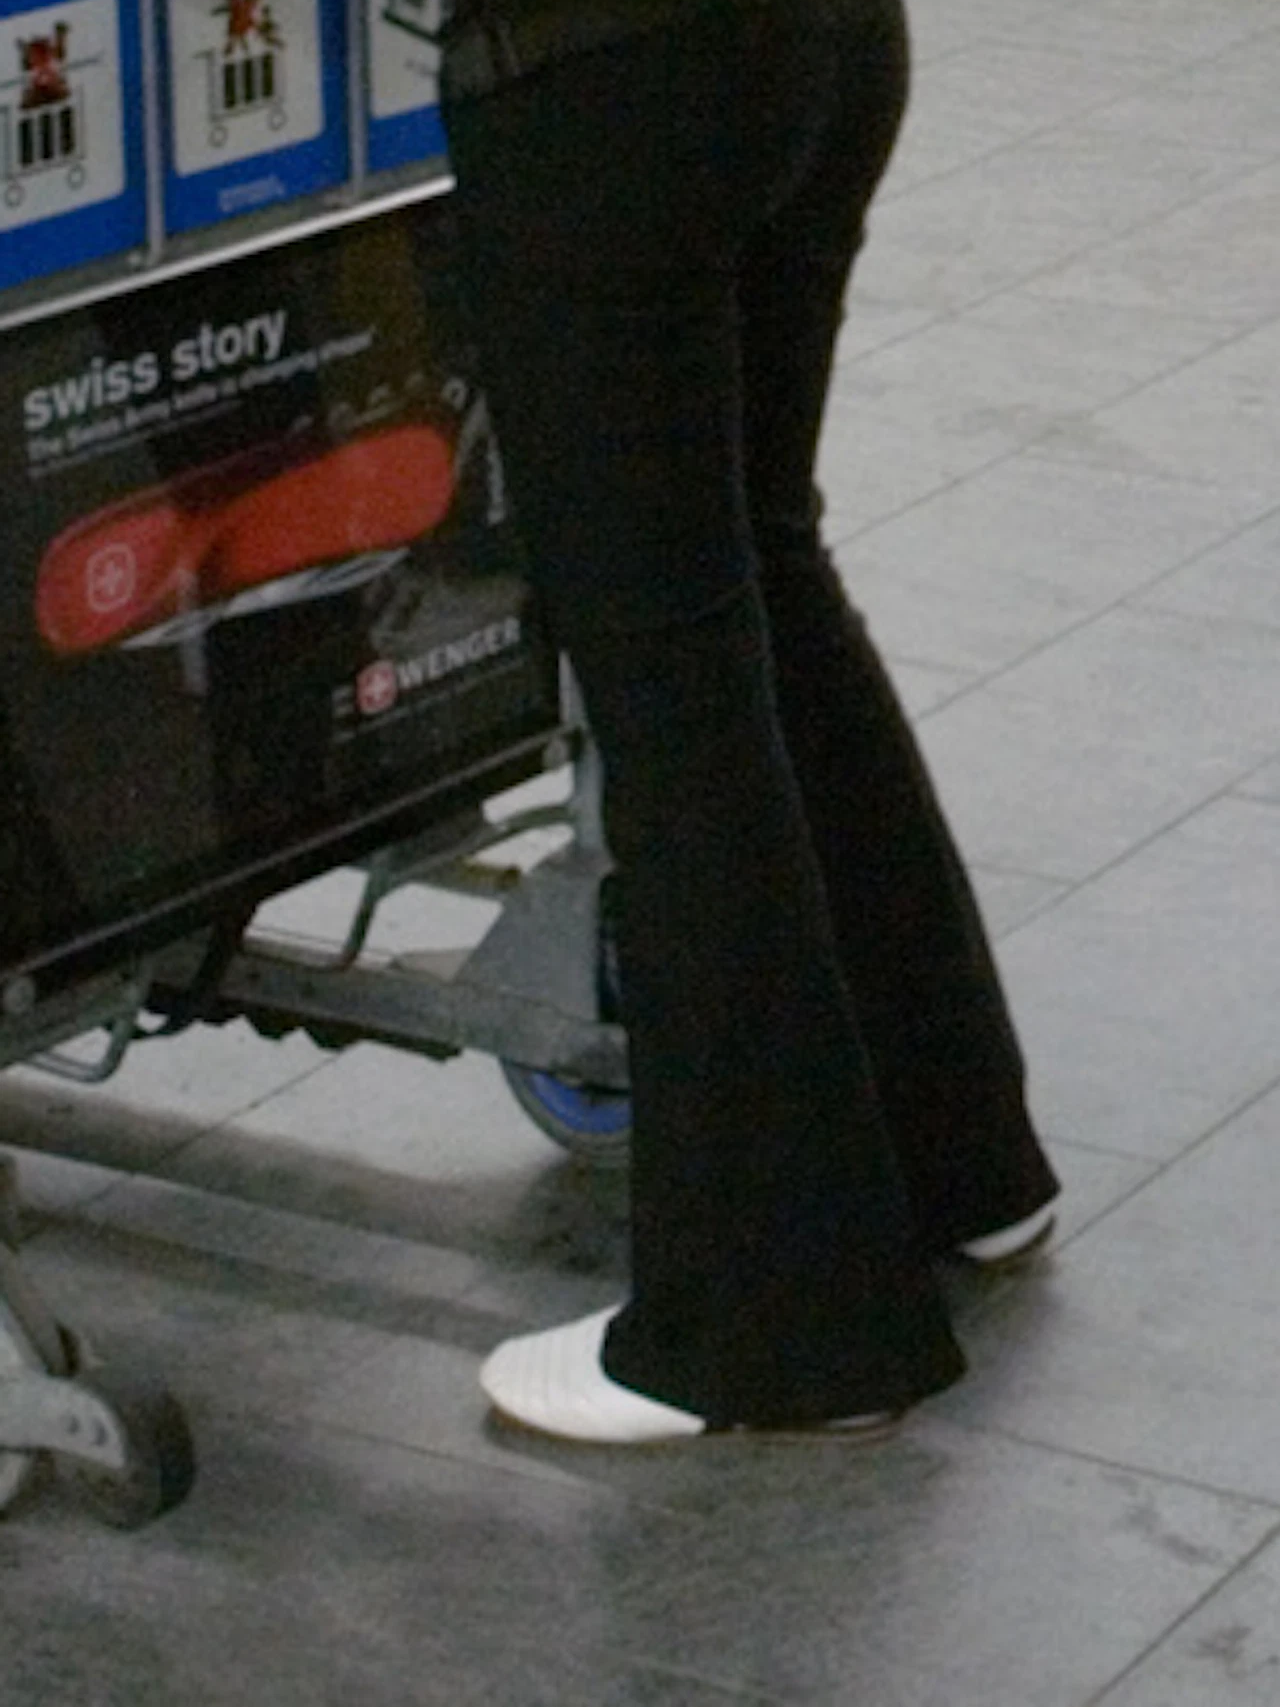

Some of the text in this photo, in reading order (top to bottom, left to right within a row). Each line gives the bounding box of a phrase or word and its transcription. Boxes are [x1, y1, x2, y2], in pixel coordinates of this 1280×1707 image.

[24, 350, 160, 432] swiss
[171, 308, 288, 381] story
[396, 615, 521, 688] WENGER
